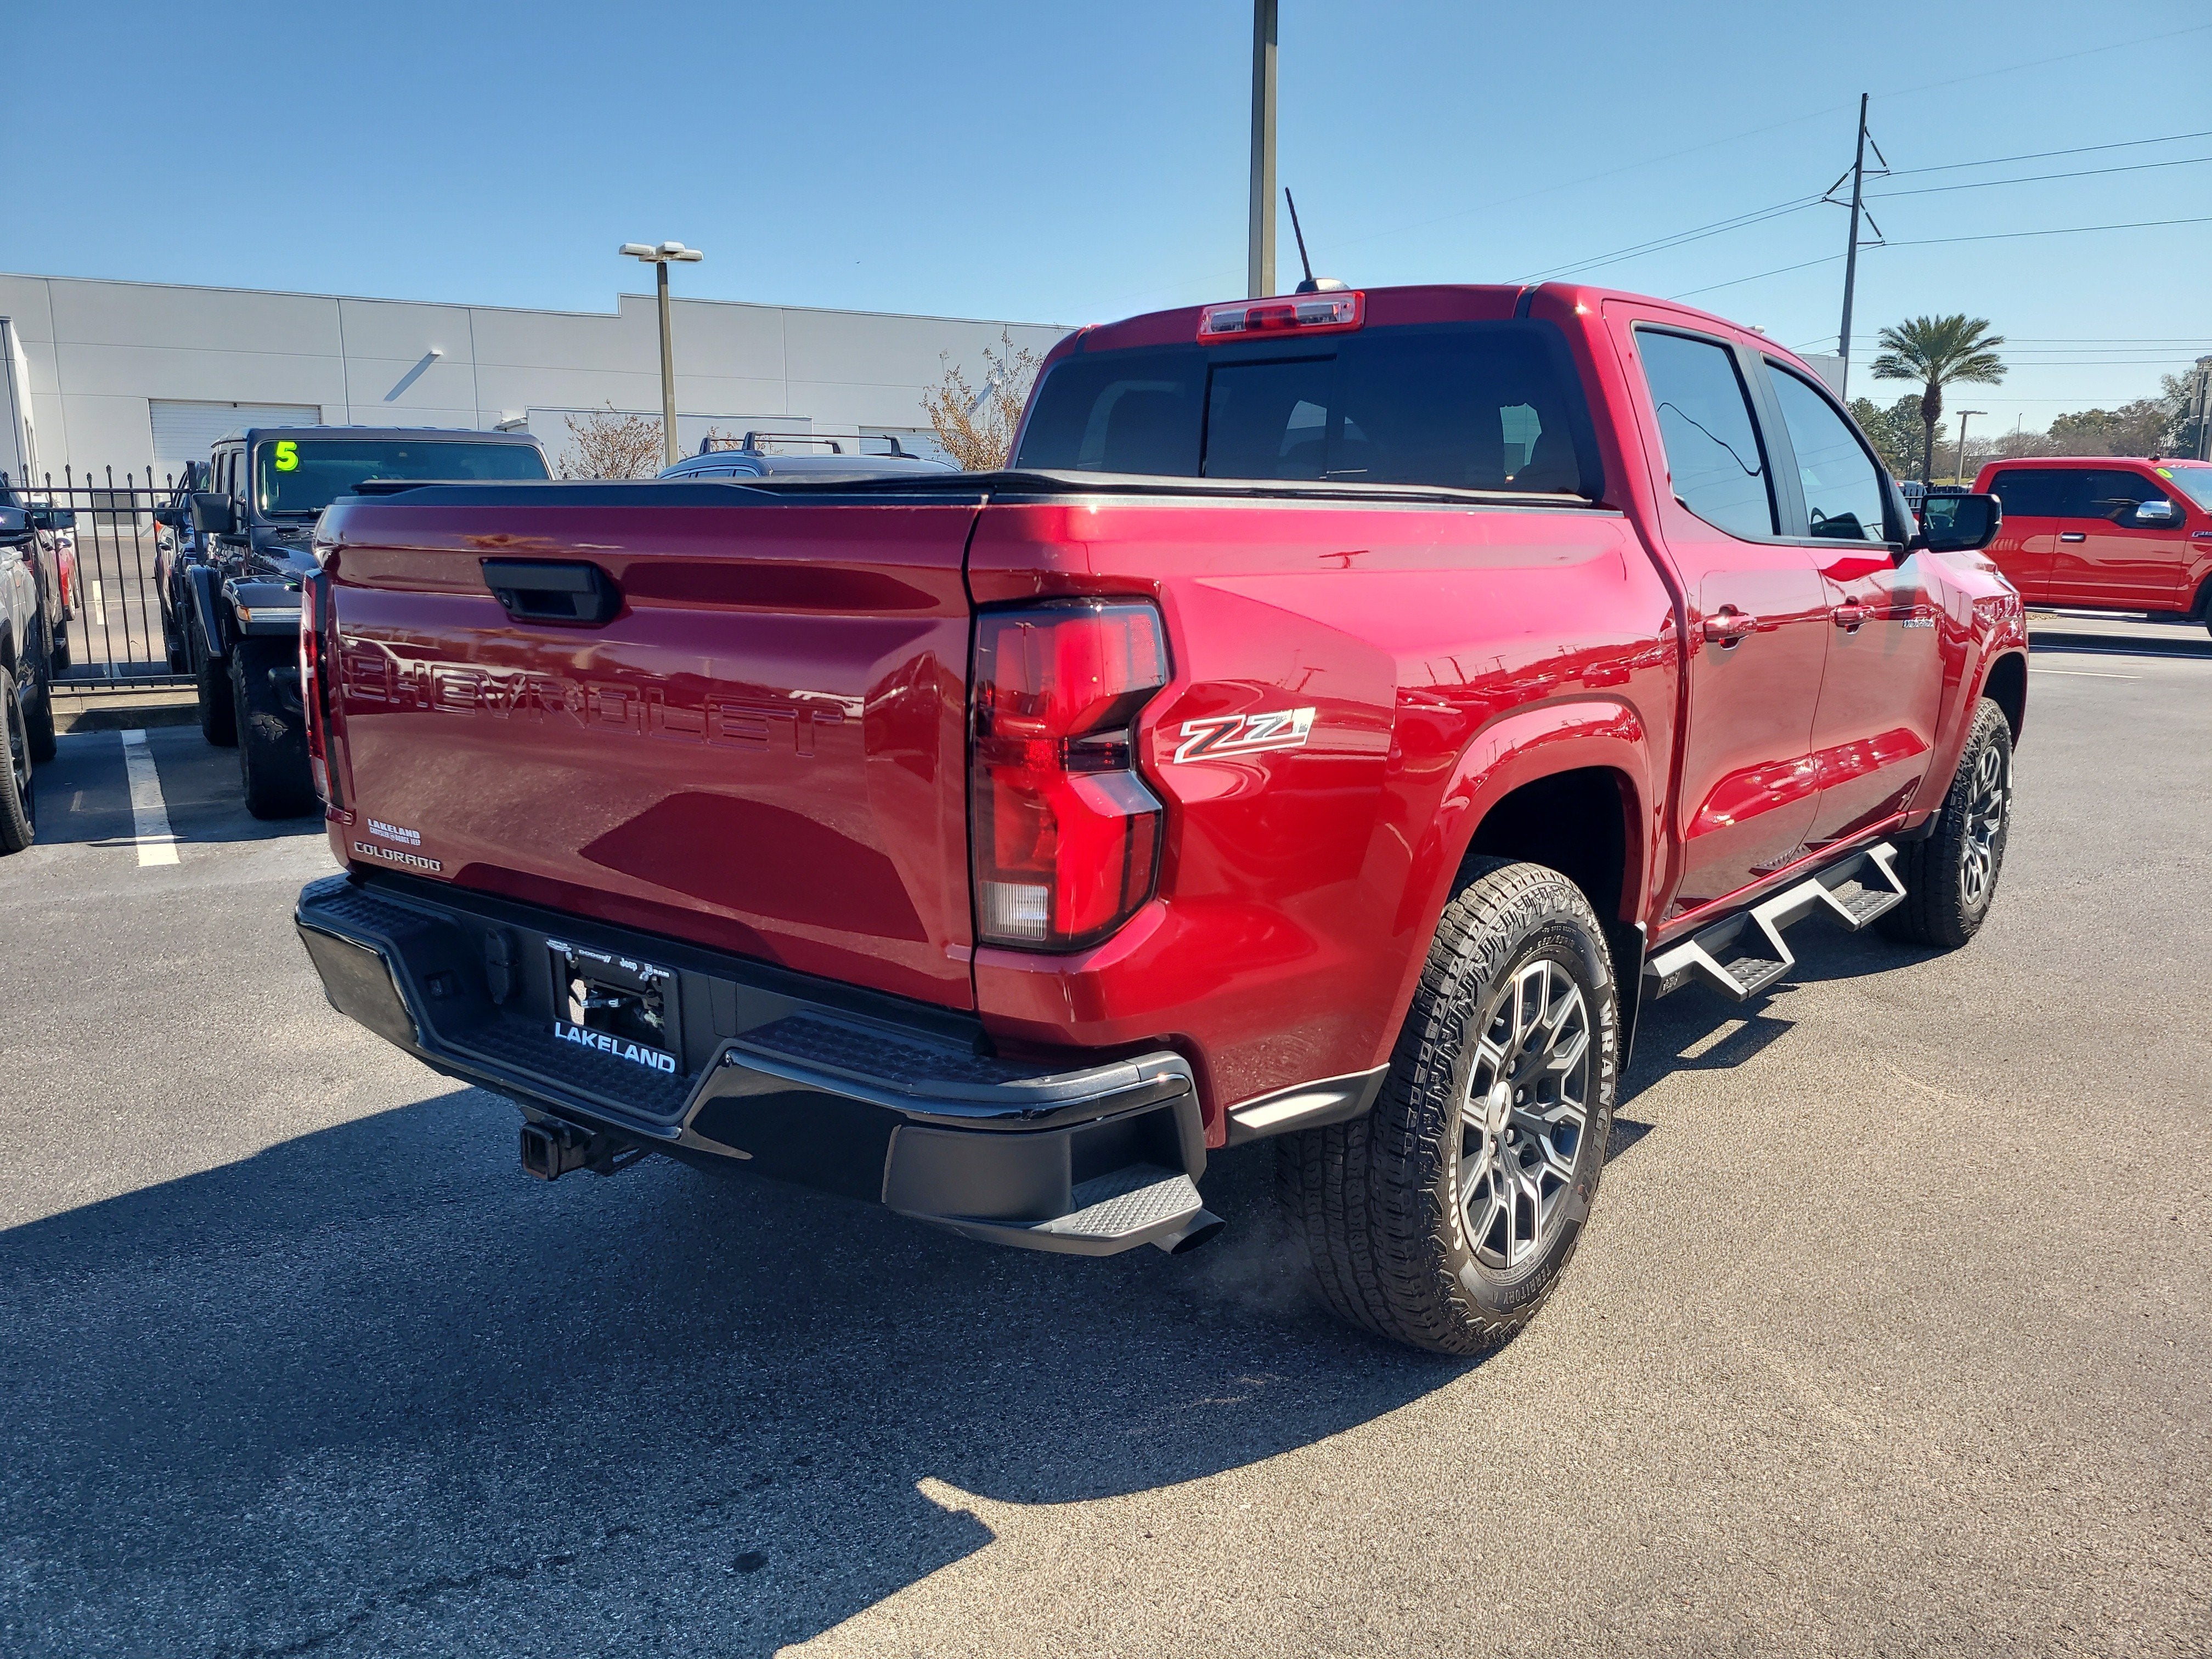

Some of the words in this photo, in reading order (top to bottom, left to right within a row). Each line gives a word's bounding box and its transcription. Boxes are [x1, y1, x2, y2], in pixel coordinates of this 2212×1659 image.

[276, 441, 298, 471] 5
[348, 654, 844, 758] CHEVROLET
[1173, 706, 1316, 764] Z71
[366, 818, 421, 839] LAKELAND
[353, 840, 442, 872] COLORADO
[619, 957, 638, 972] Jeep
[555, 1022, 676, 1074] LAKELAND
[1503, 1263, 1553, 1305] TERRITORY
